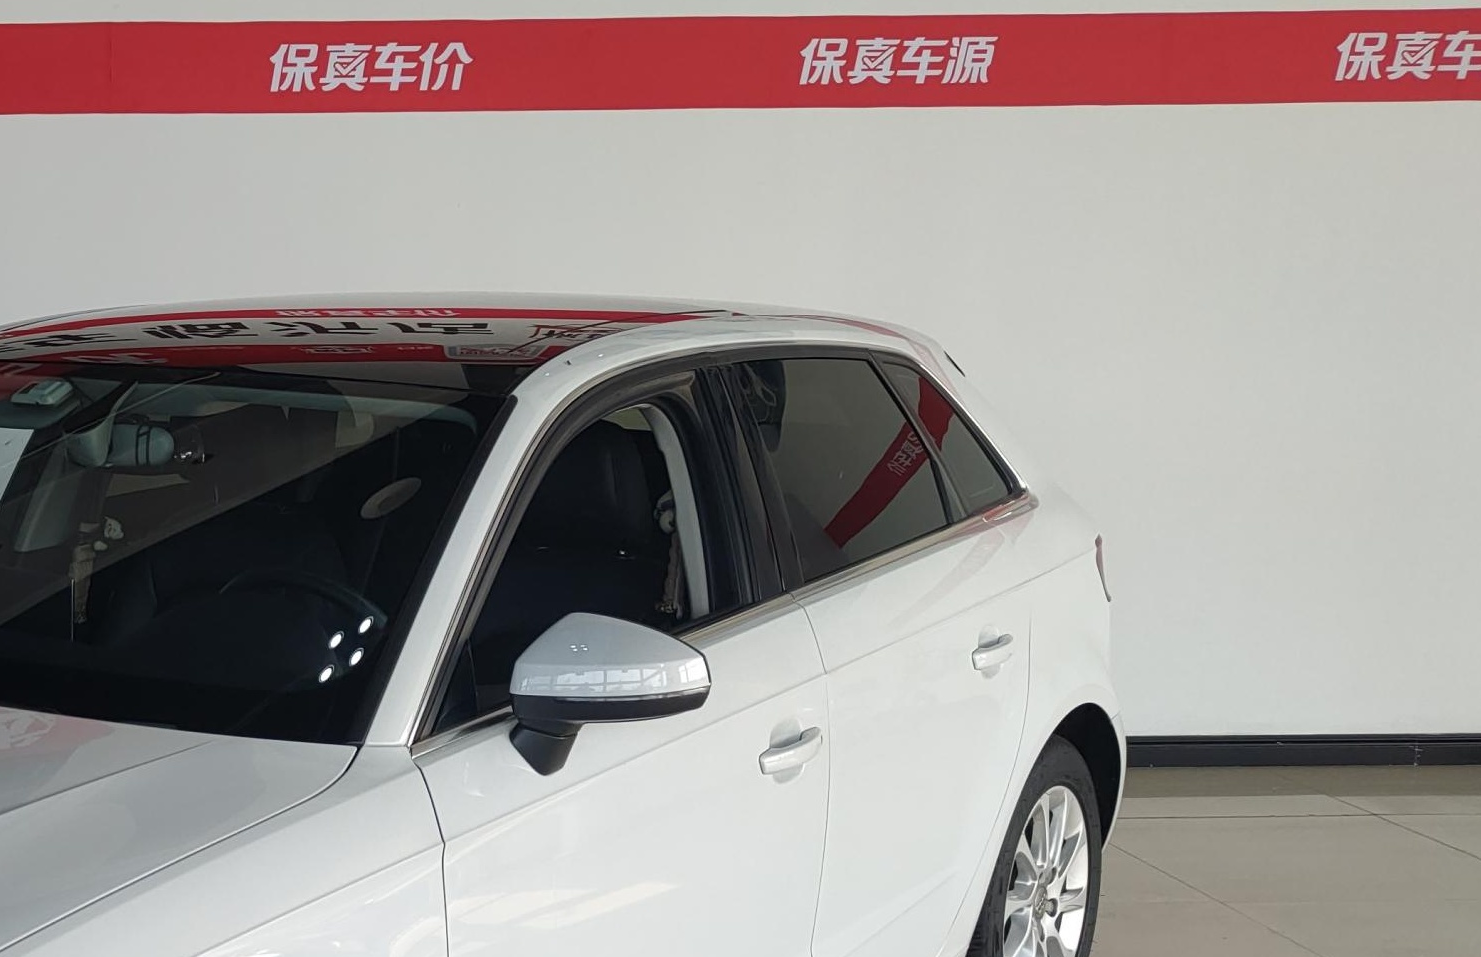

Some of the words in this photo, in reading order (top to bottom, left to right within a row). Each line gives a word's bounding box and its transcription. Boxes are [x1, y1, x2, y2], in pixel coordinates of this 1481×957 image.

[270, 43, 473, 92] 保真车价
[800, 37, 998, 84] 保真车源
